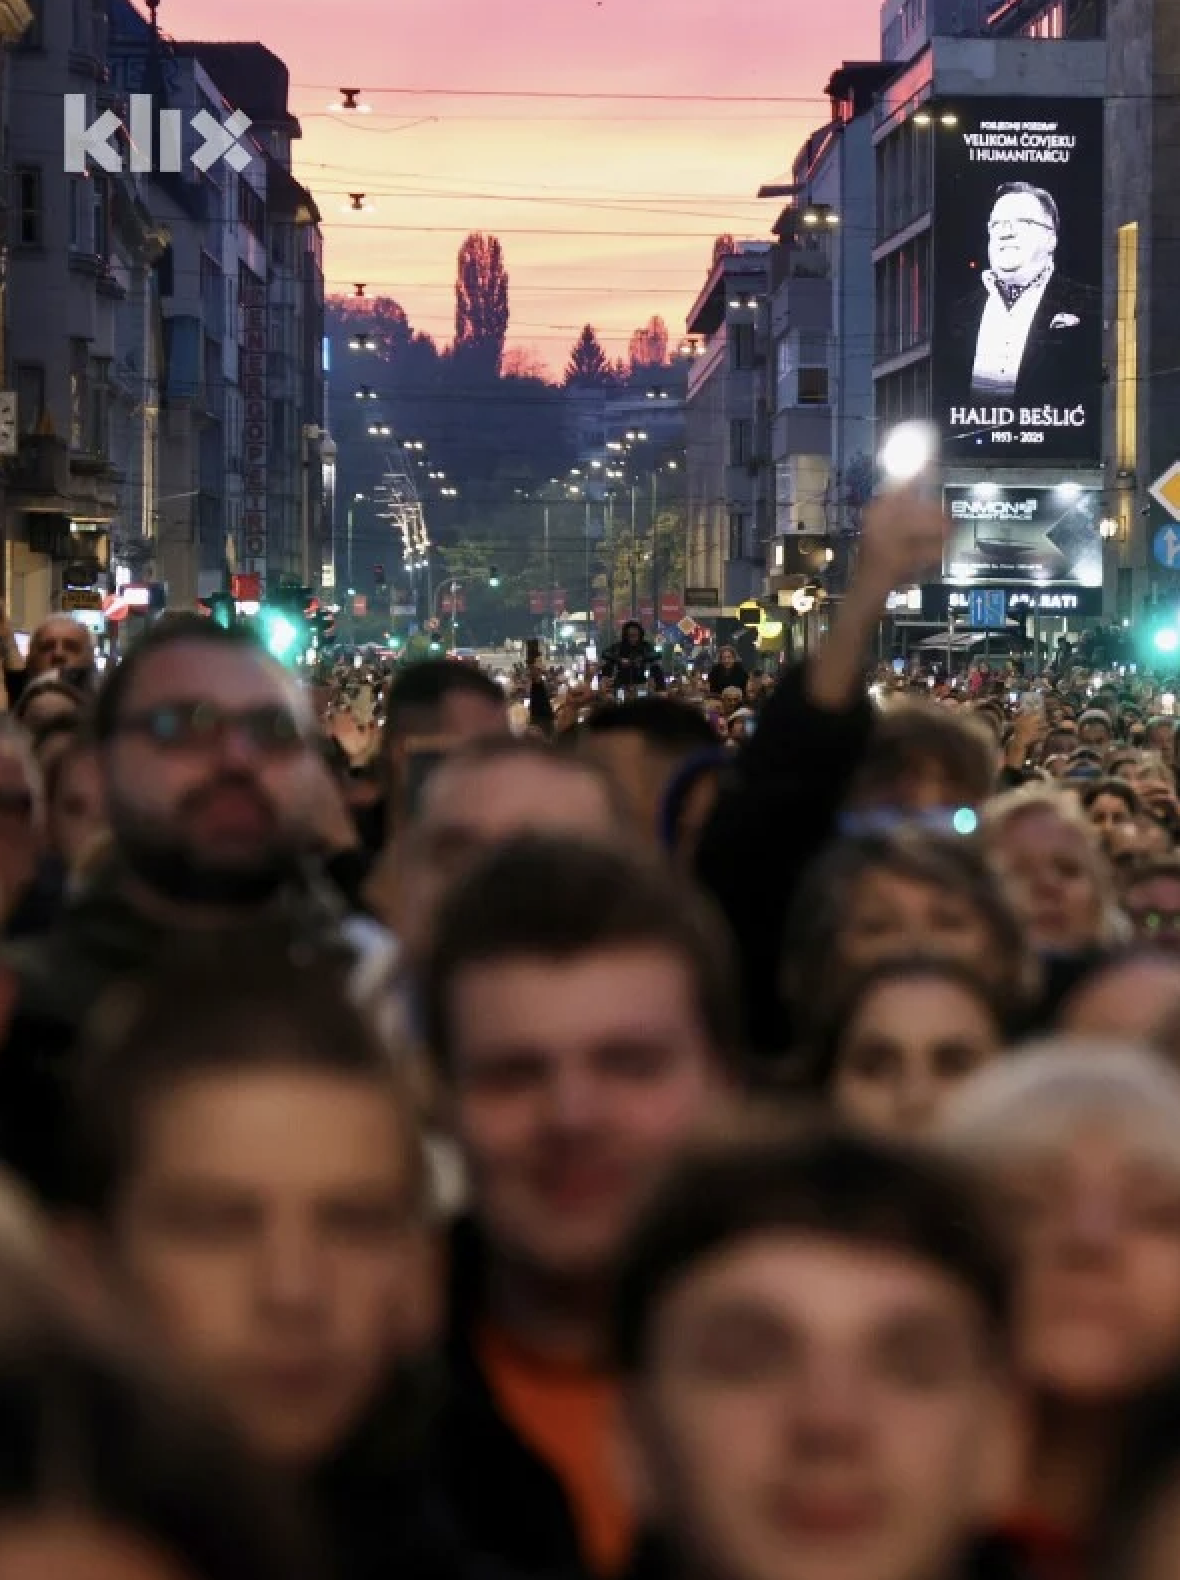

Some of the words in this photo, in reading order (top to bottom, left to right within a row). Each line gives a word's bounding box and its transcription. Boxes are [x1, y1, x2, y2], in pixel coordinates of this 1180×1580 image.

[963, 133, 1018, 147] VELIKOM
[1019, 132, 1076, 147] ČOVJEKU
[977, 149, 1070, 162] HUMANITARCU
[950, 407, 1014, 424] HALID
[1019, 403, 1085, 426] BEŠLIĆ
